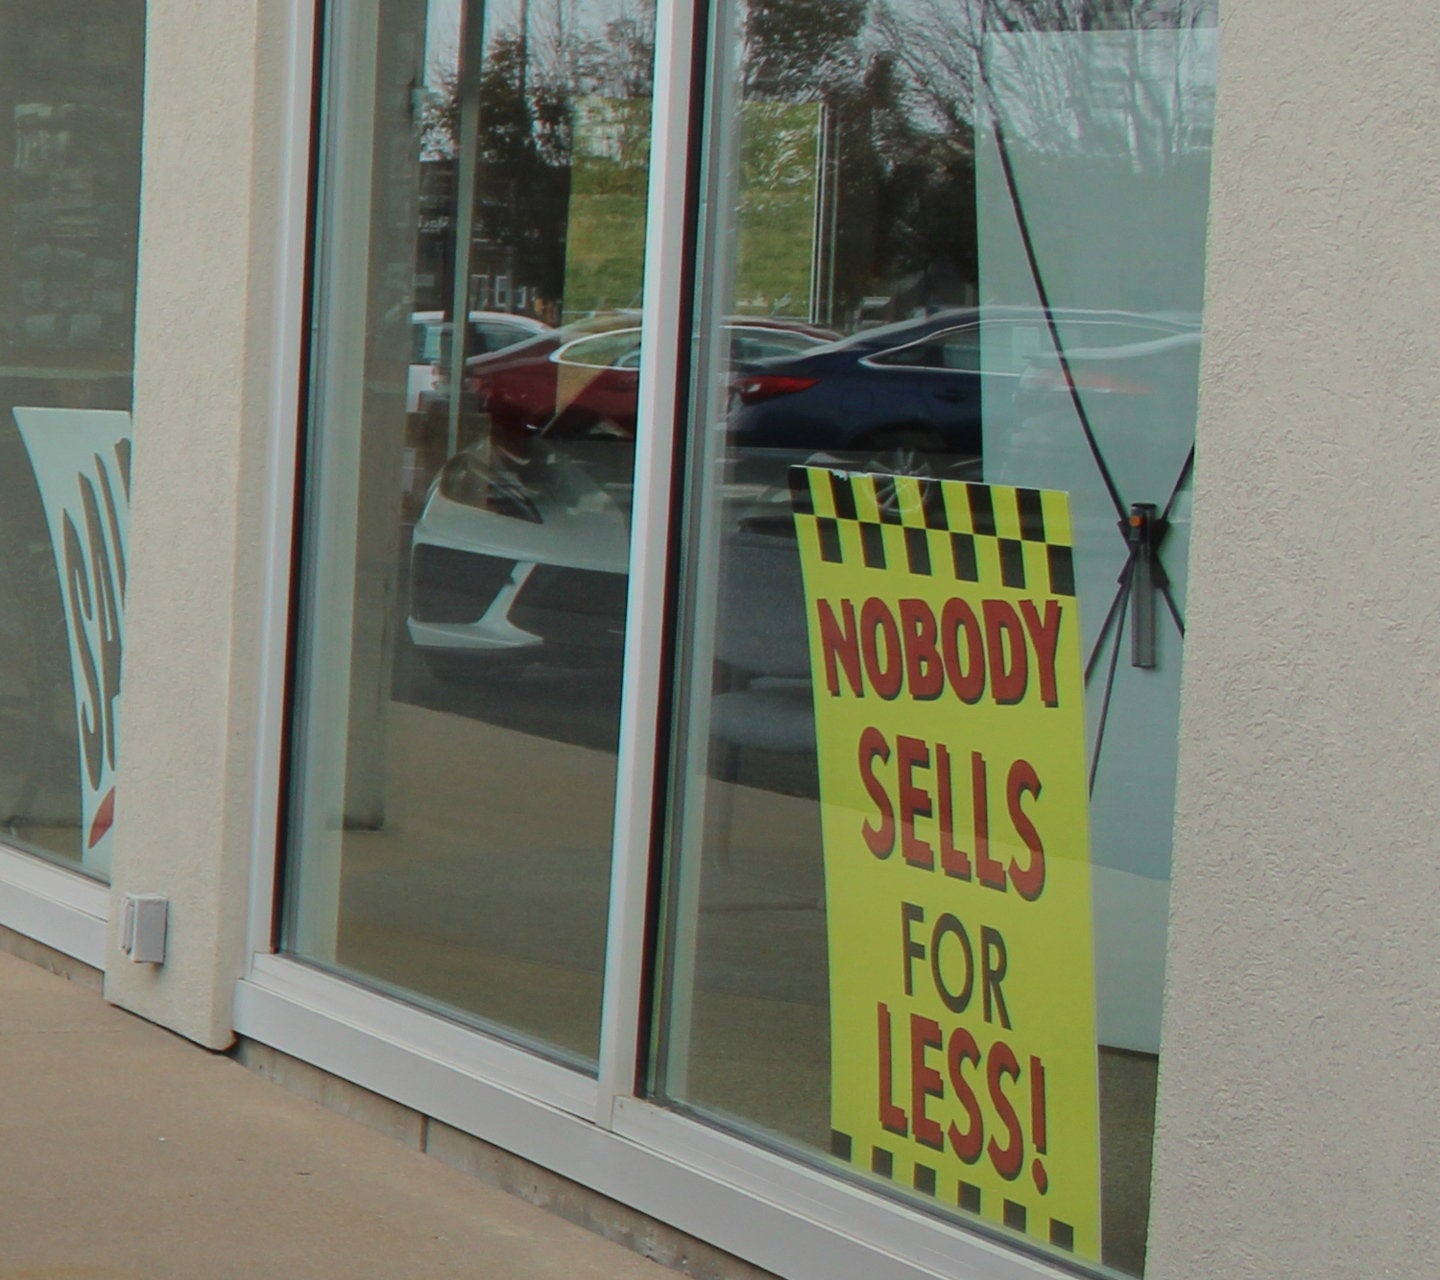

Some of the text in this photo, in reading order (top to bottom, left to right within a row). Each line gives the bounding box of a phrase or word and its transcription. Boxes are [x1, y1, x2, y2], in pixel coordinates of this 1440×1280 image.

[816, 597, 1062, 708] NOBODY
[858, 726, 1045, 902] SELLS
[901, 901, 1011, 1030] FOR
[878, 1001, 1049, 1195] LESS!
